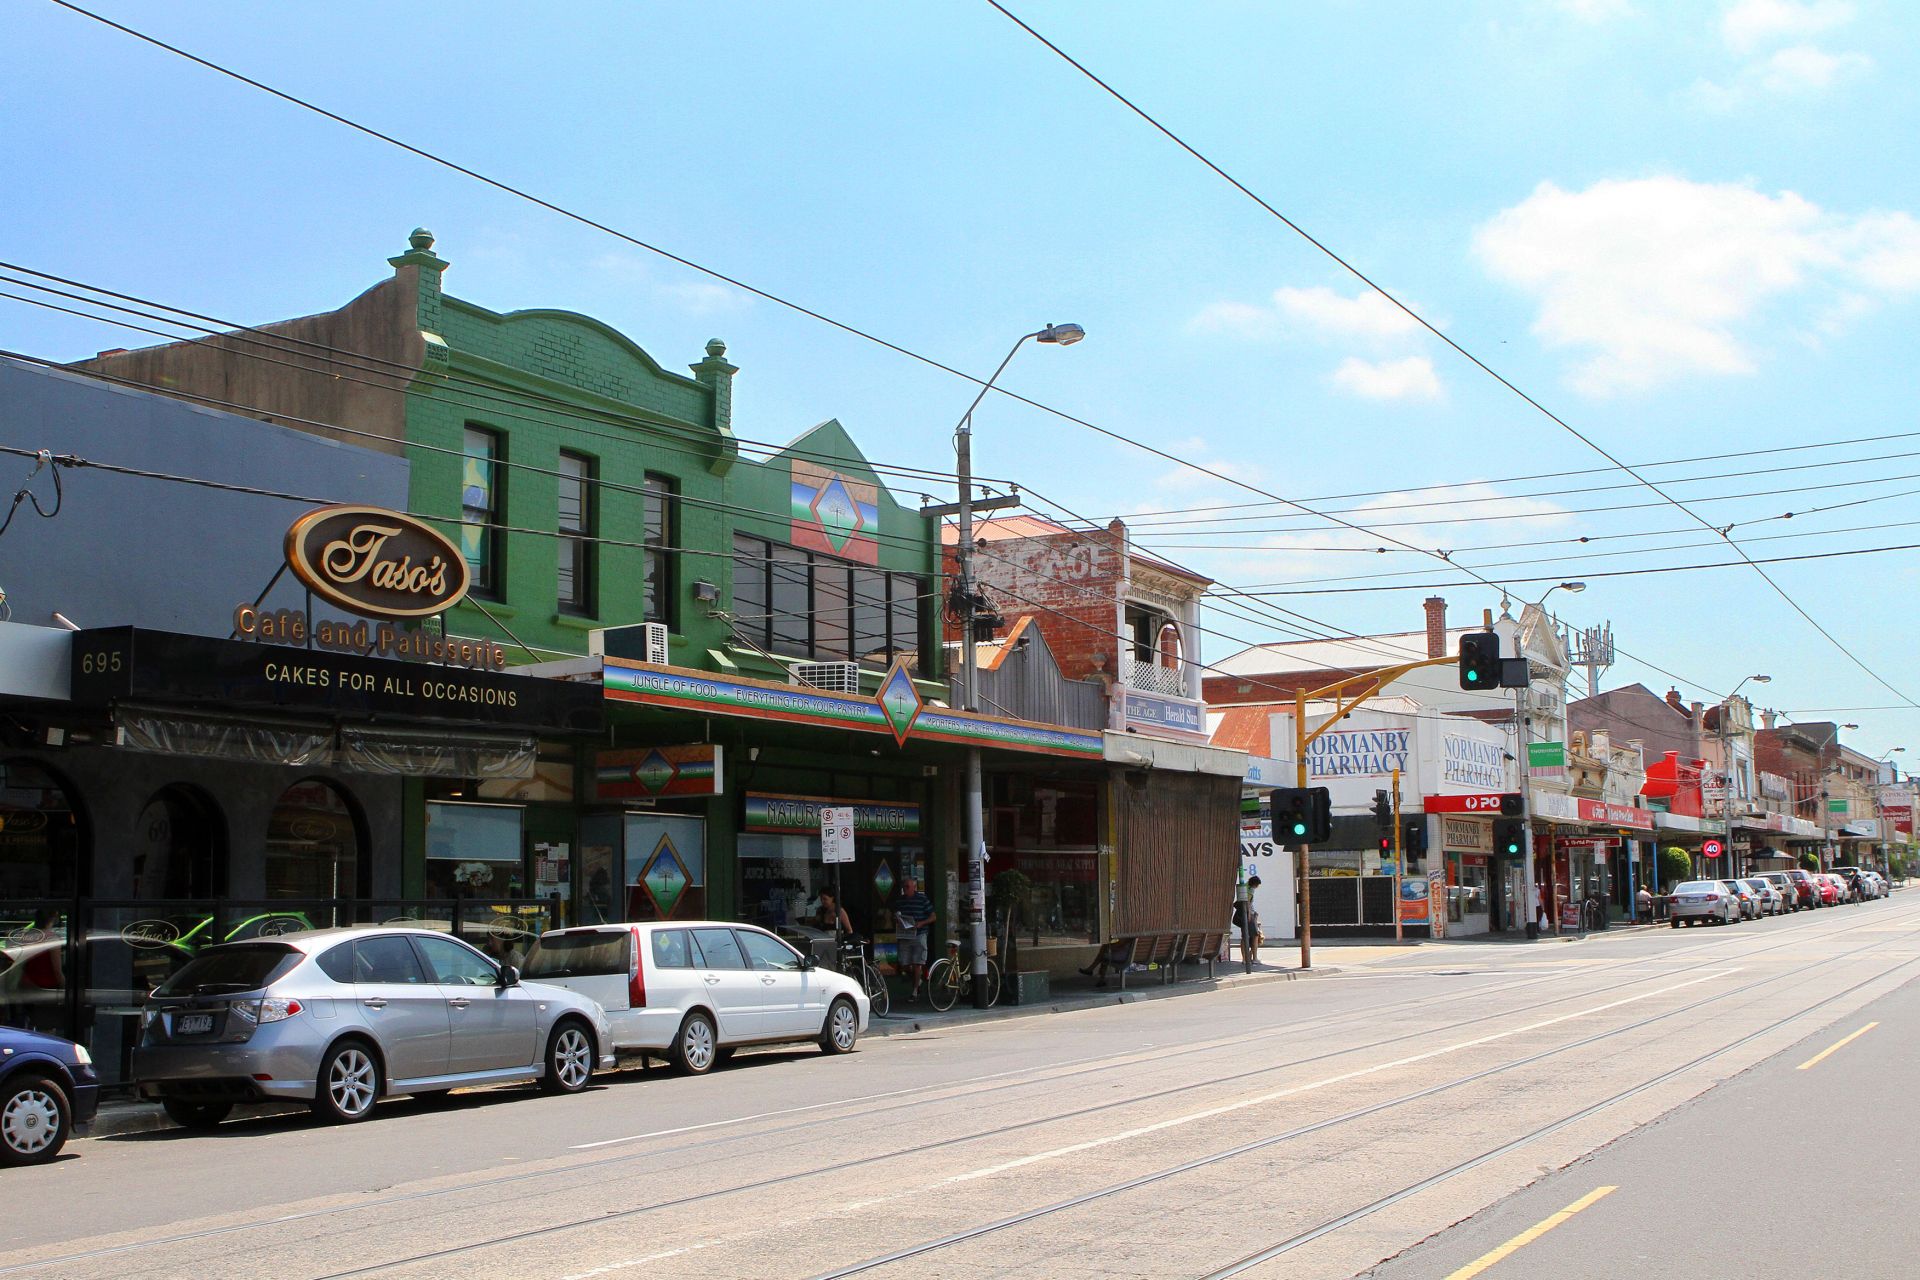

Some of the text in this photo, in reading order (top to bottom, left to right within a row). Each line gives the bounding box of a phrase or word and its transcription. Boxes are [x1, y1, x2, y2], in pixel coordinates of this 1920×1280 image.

[322, 524, 448, 596] Taso's
[239, 607, 505, 665] Café and Patisserie
[83, 651, 121, 673] 695
[265, 663, 517, 707] CAKES FOR ALL OCCASIONS
[631, 674, 670, 693] JUNGLE
[673, 679, 688, 693] OF
[690, 683, 718, 698] FOOD
[792, 694, 812, 710] FOR
[813, 698, 836, 714] YOUR
[1126, 704, 1157, 719] THE AGE
[1165, 706, 1198, 725] Herald Sun
[1445, 737, 1501, 766] NORMANBY
[1444, 759, 1503, 787] PHARMACY
[1481, 797, 1501, 809] PO
[767, 801, 905, 830] NATURA ON HIGH
[825, 828, 835, 838] 1P
[1446, 820, 1479, 834] NORMANBY
[1446, 832, 1480, 845] PHARMACY
[1241, 842, 1273, 857] AYS
[1706, 845, 1718, 853] 40
[1430, 881, 1443, 938] CHEMIST
[127, 924, 171, 943] Taso's
